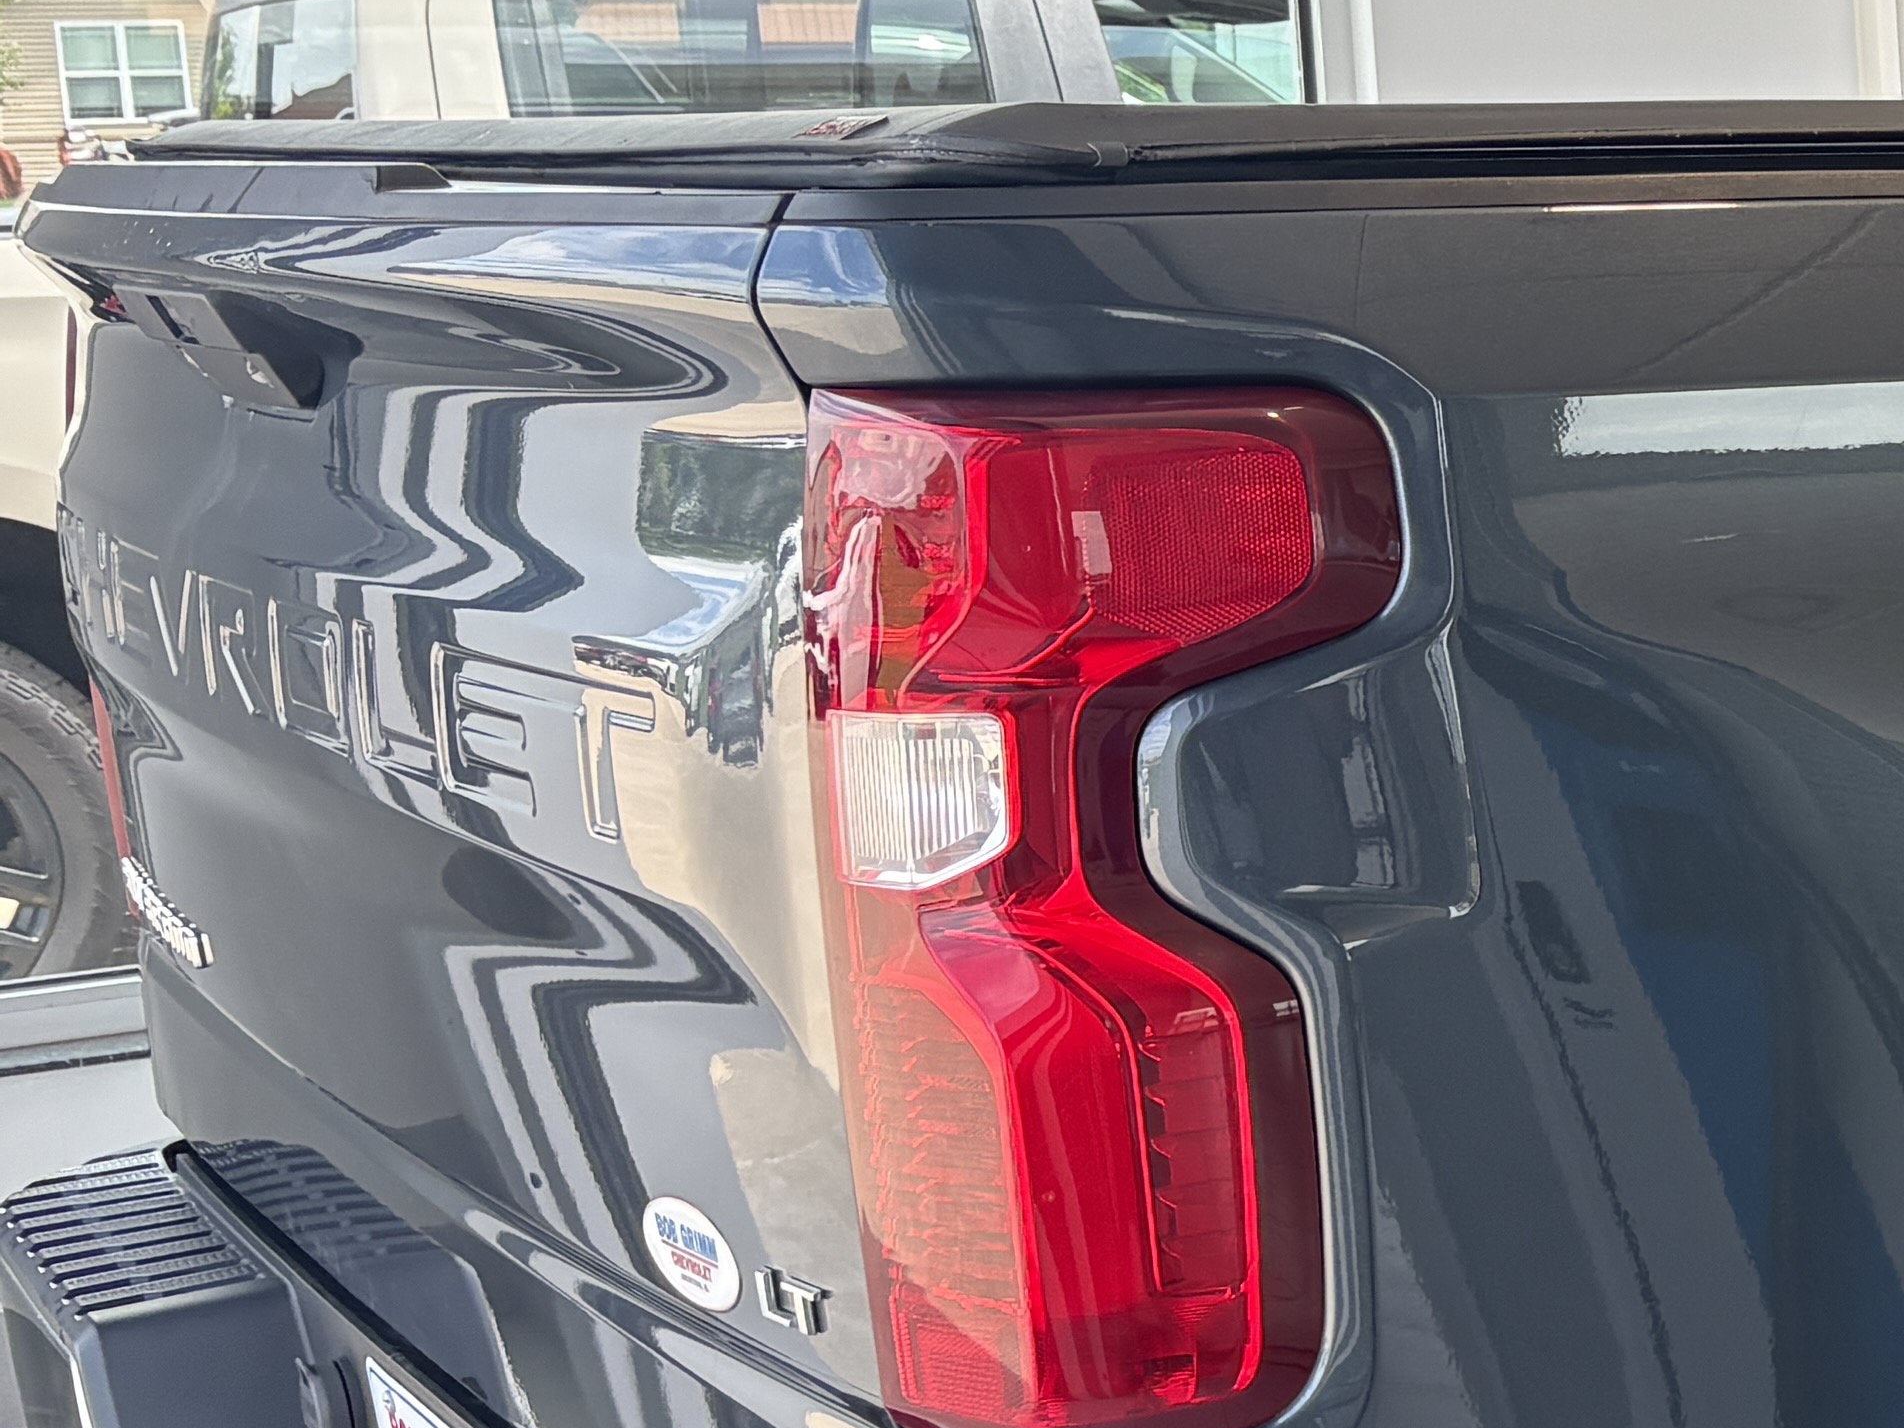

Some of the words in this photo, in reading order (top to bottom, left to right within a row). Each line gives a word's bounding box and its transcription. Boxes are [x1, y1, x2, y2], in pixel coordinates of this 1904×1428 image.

[655, 1212, 679, 1244] BOB
[680, 1223, 719, 1264] GRIMM
[754, 1267, 822, 1336] LT
